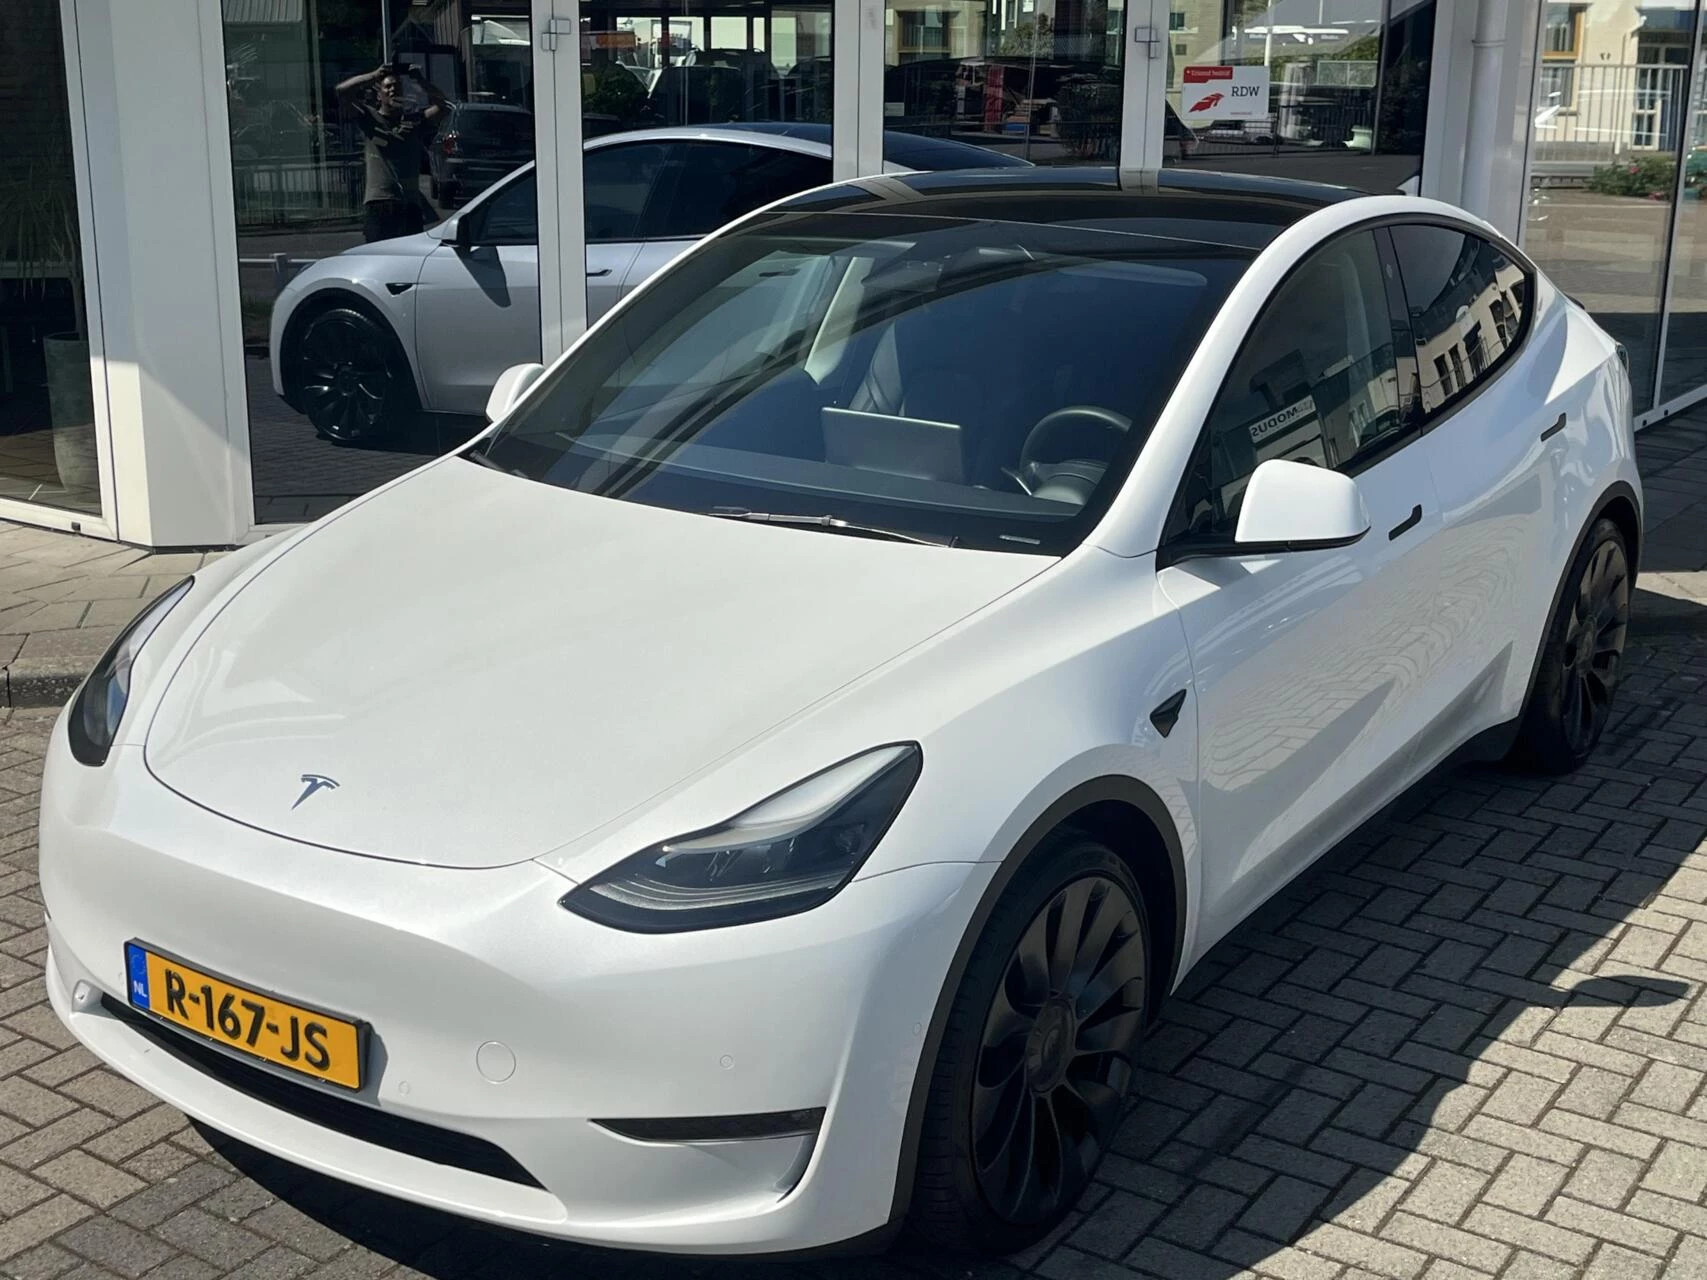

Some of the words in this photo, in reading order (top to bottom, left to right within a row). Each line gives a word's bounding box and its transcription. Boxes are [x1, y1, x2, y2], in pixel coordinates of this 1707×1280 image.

[1231, 86, 1260, 97] RDW
[133, 980, 148, 998] NL
[165, 968, 330, 1071] R-167-JS
